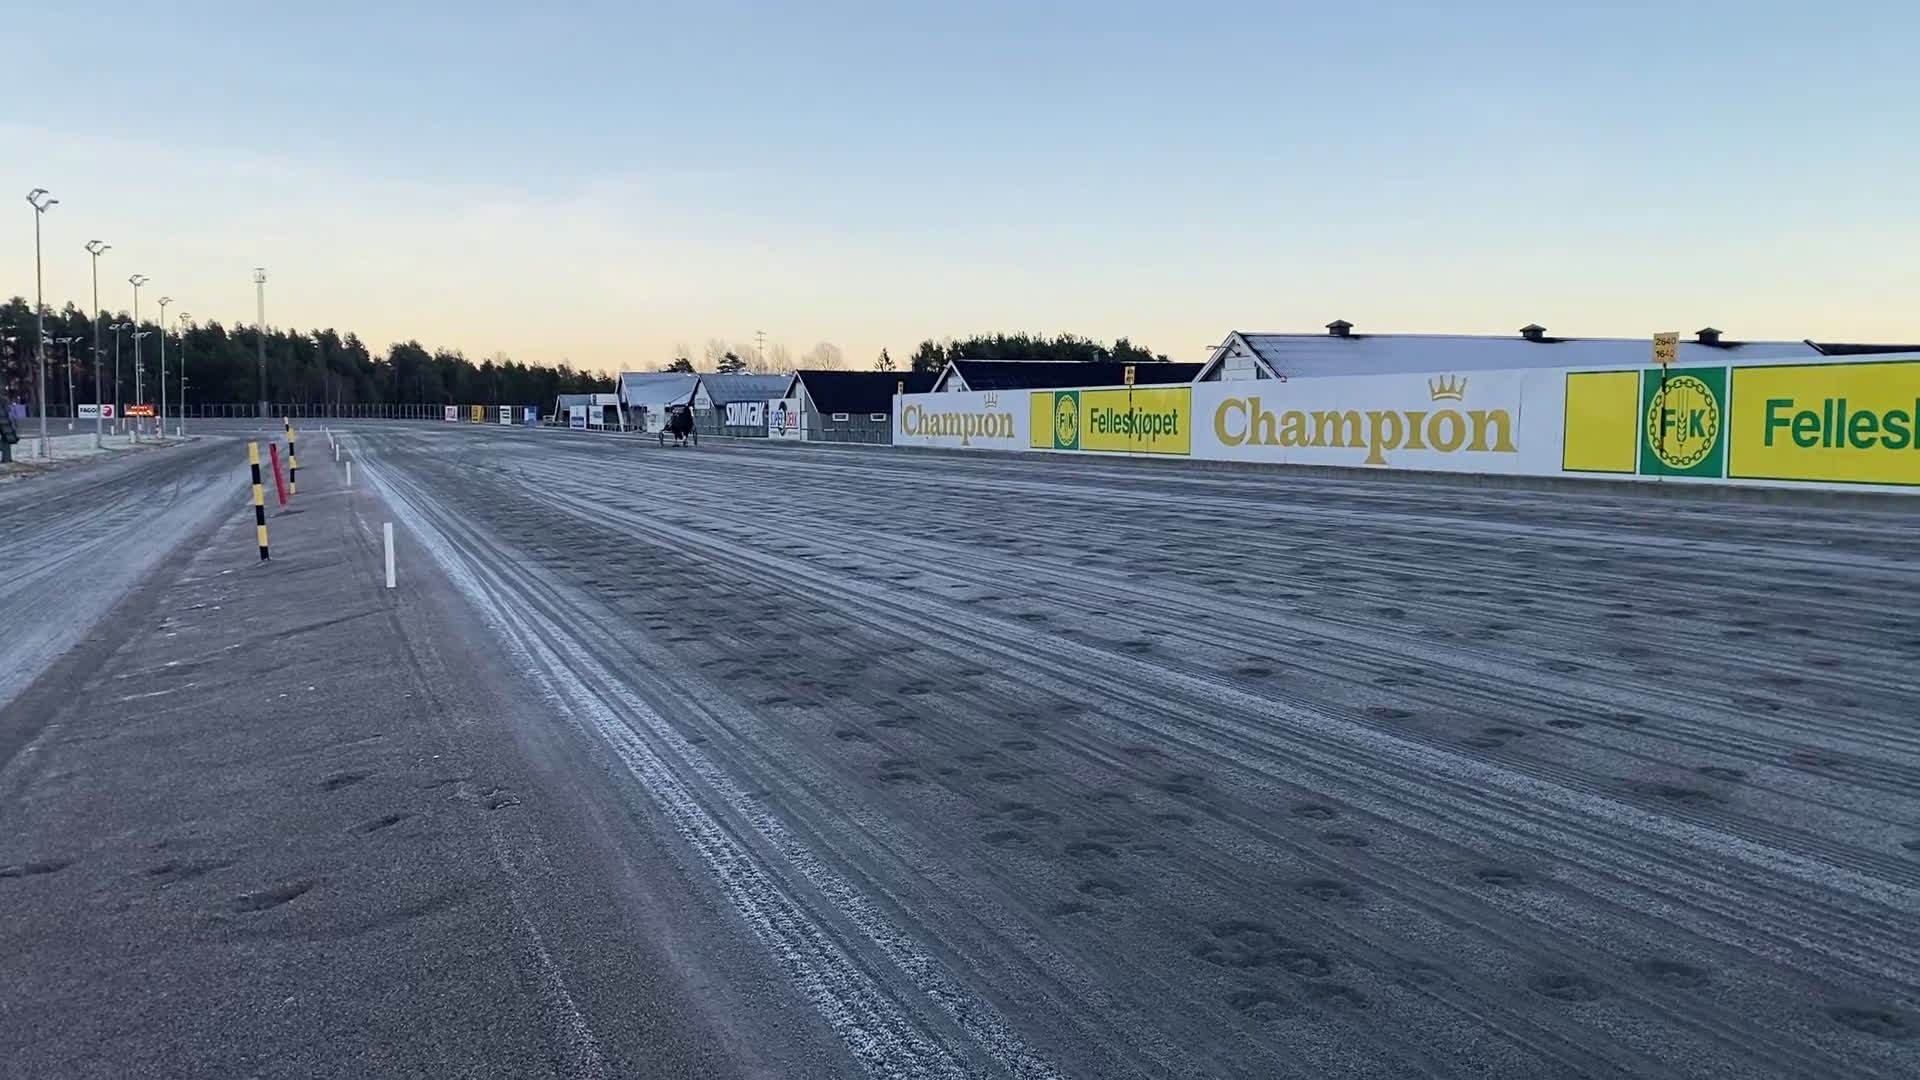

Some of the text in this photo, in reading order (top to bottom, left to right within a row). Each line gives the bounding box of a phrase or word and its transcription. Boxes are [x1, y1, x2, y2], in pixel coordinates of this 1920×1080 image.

[902, 404, 1016, 446] Champion
[1090, 407, 1179, 441] Felleskjøpet
[1213, 397, 1518, 466] Champion
[1764, 397, 1920, 450] Felles
